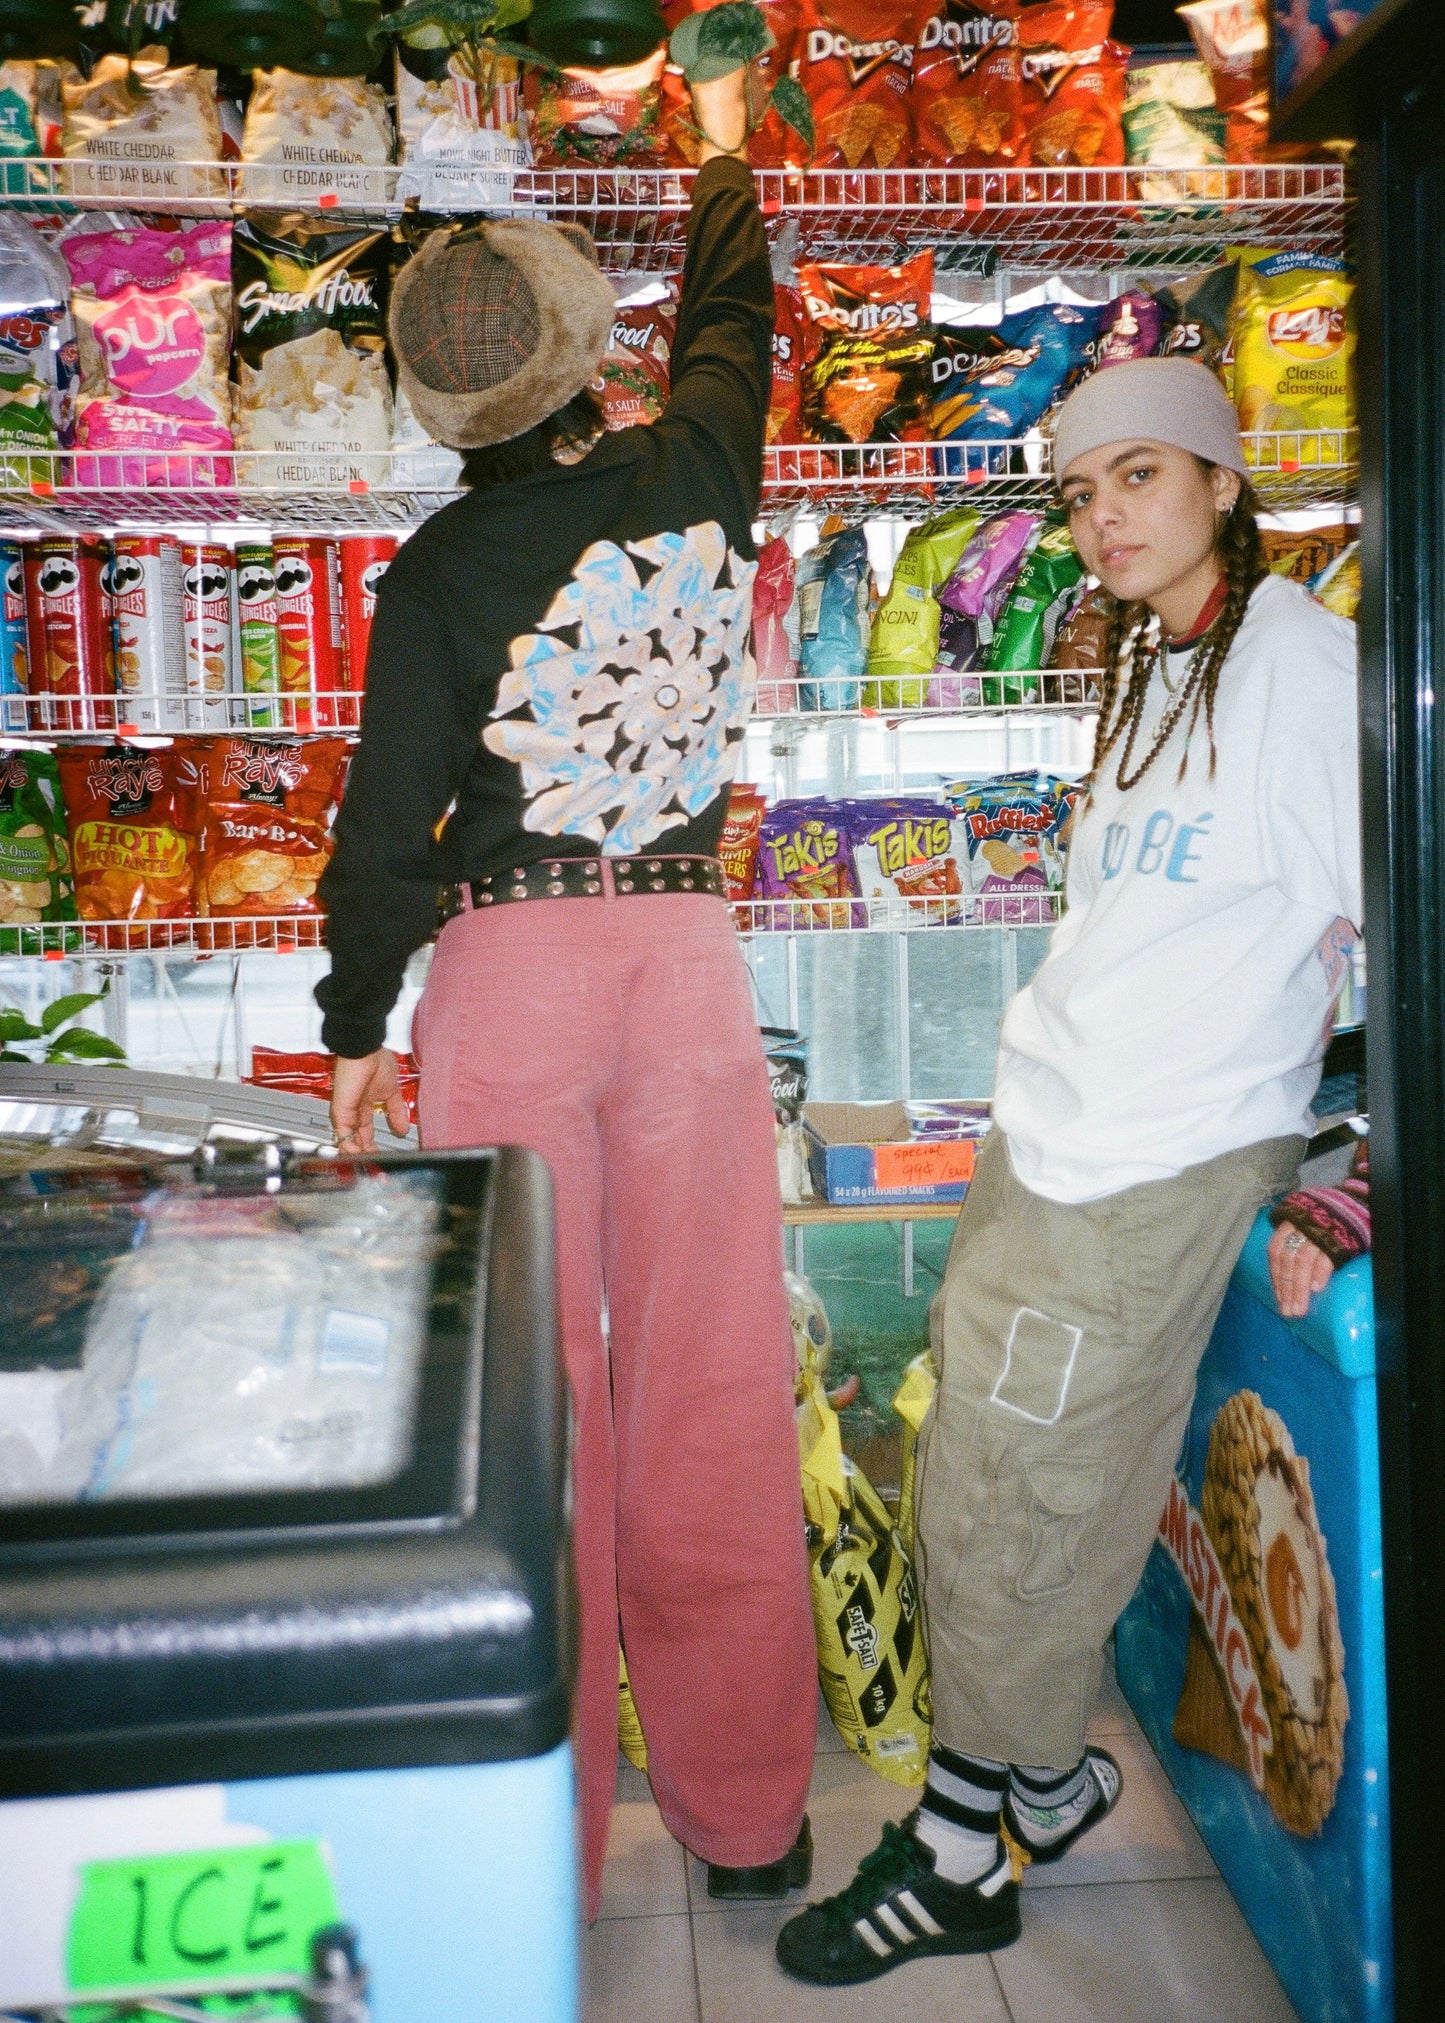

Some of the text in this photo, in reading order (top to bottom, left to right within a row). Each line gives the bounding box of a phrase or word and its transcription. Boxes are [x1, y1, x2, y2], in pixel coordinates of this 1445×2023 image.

[86, 139, 175, 159] WHITE CHEDDAR
[281, 144, 316, 162] WHITE
[467, 150, 491, 162] NIGHT
[494, 147, 527, 165] BUTTER
[142, 168, 178, 185] BLANC
[804, 295, 918, 331] Doritos
[1274, 306, 1344, 346] Lay's
[146, 347, 200, 366] popcorn
[1285, 365, 1338, 381] Classic
[1276, 381, 1347, 397] Classique
[615, 399, 641, 412] SALTY
[110, 417, 183, 437] SALTY
[16, 429, 48, 444] ONION
[94, 823, 163, 856] HOT
[869, 818, 949, 877] Takis
[9, 844, 41, 859] Onion
[766, 821, 839, 881] Takis
[80, 848, 170, 873] PIQUANTE
[989, 884, 1008, 892] ALL
[893, 1144, 945, 1160] special
[835, 1187, 845, 1197] 54
[851, 1186, 860, 1197] 28
[867, 1186, 907, 1196] FLAVOURED
[908, 1185, 935, 1194] SNACKS
[872, 1684, 887, 1713] 10 kg
[132, 1858, 286, 1966] ICE
